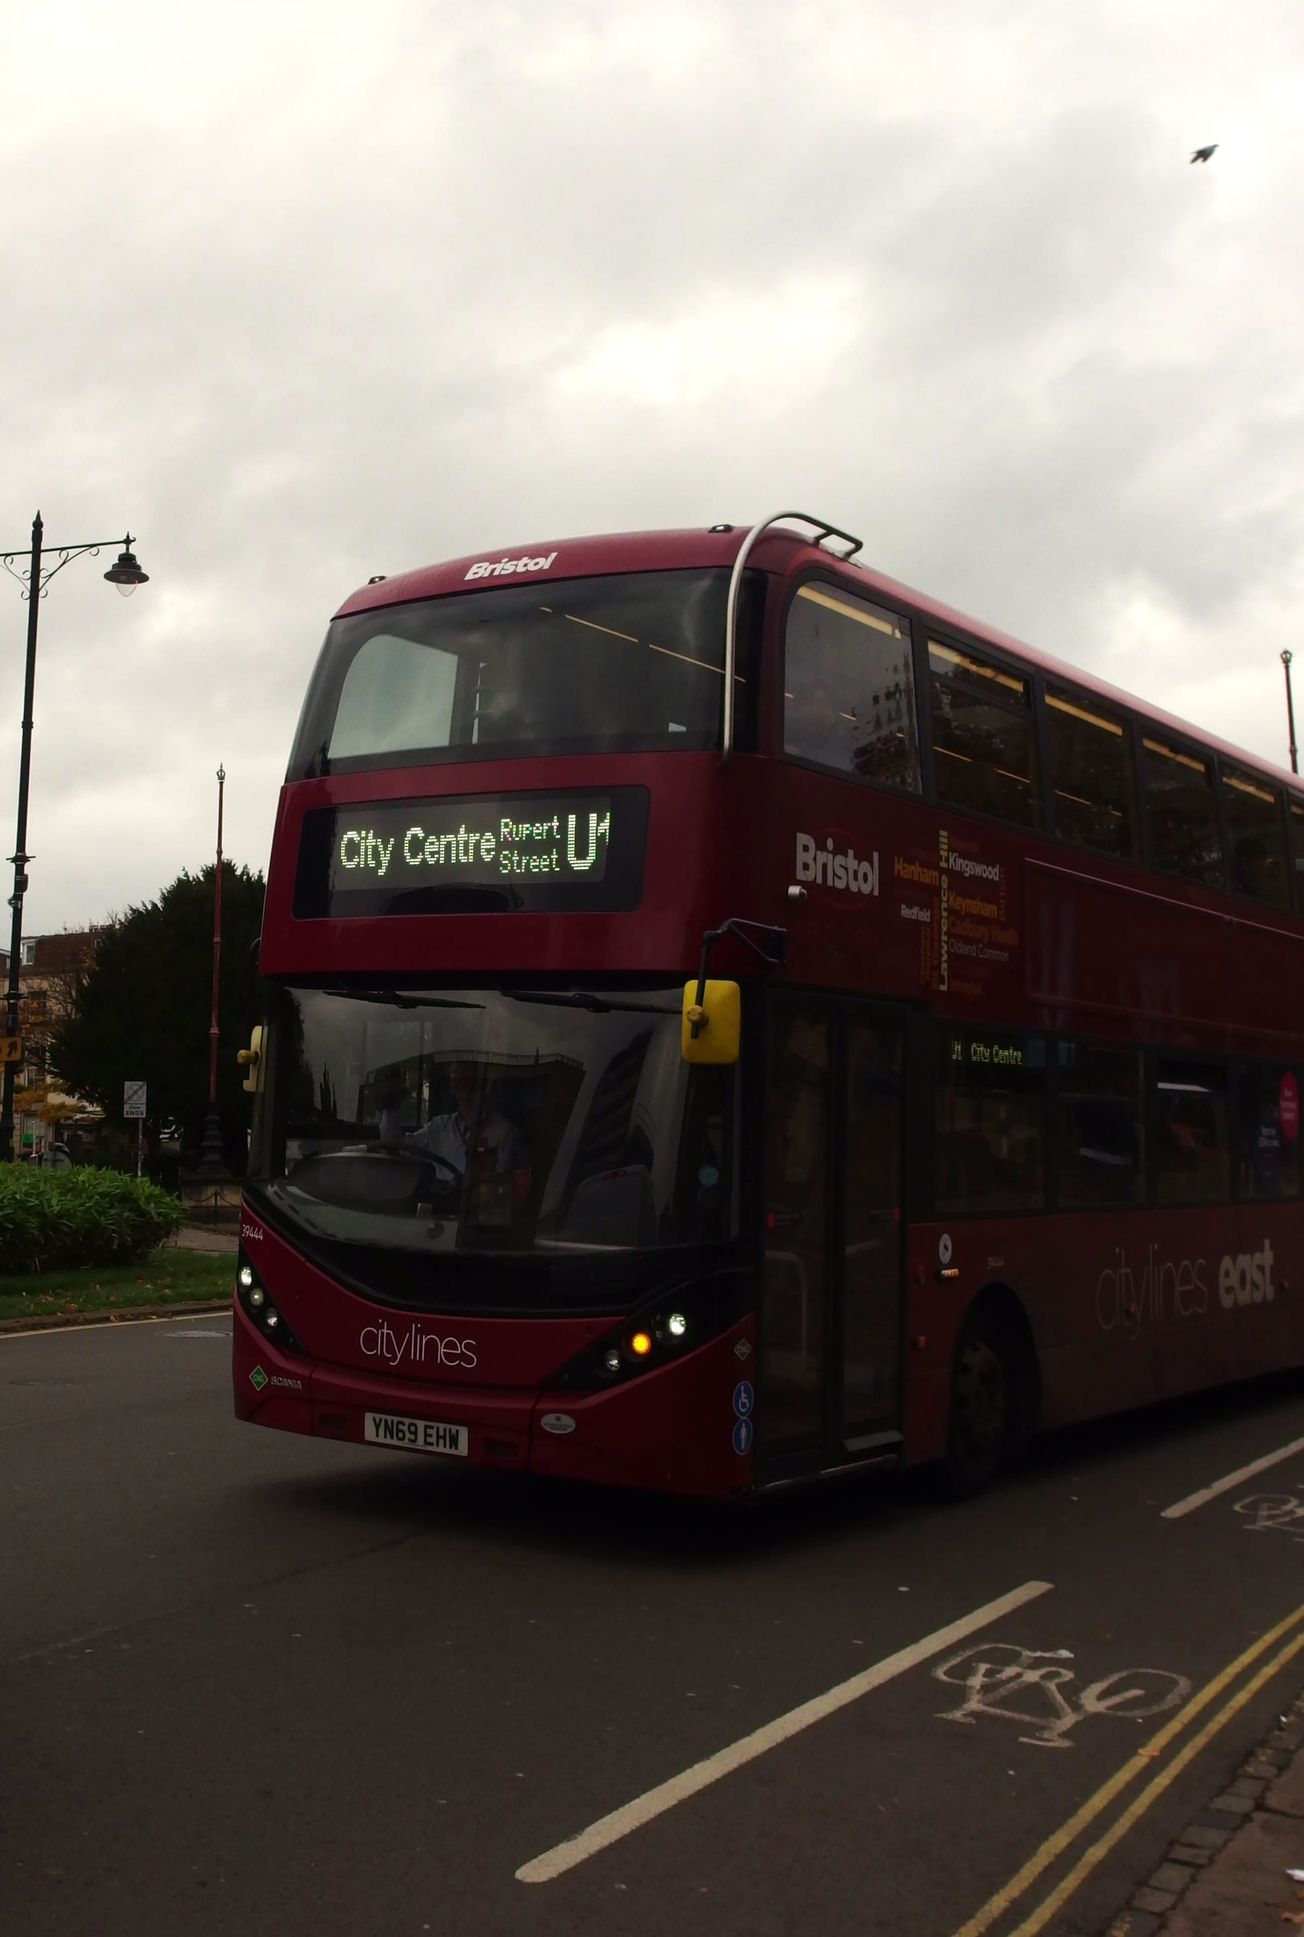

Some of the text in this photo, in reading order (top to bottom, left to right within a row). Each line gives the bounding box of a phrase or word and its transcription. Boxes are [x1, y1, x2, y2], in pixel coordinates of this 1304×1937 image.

[464, 552, 558, 581] Bristol
[500, 815, 560, 842] Rupert
[340, 826, 496, 876] City Centre
[500, 848, 560, 873] Street
[796, 832, 879, 896] Bristol
[894, 856, 939, 886] Hanham
[949, 852, 1000, 881] Kingswood
[901, 904, 931, 922] Redfield
[939, 830, 949, 991] Lawrence Hill
[950, 891, 999, 920] Keynsham
[971, 1042, 990, 1062] City
[993, 1045, 1022, 1065] Centre
[242, 1224, 263, 1240] 39444
[1097, 1239, 1275, 1341] citylines east
[360, 1319, 478, 1368] citylines
[271, 1376, 303, 1391] SCANIA
[373, 1417, 459, 1450] YN69 EHW
